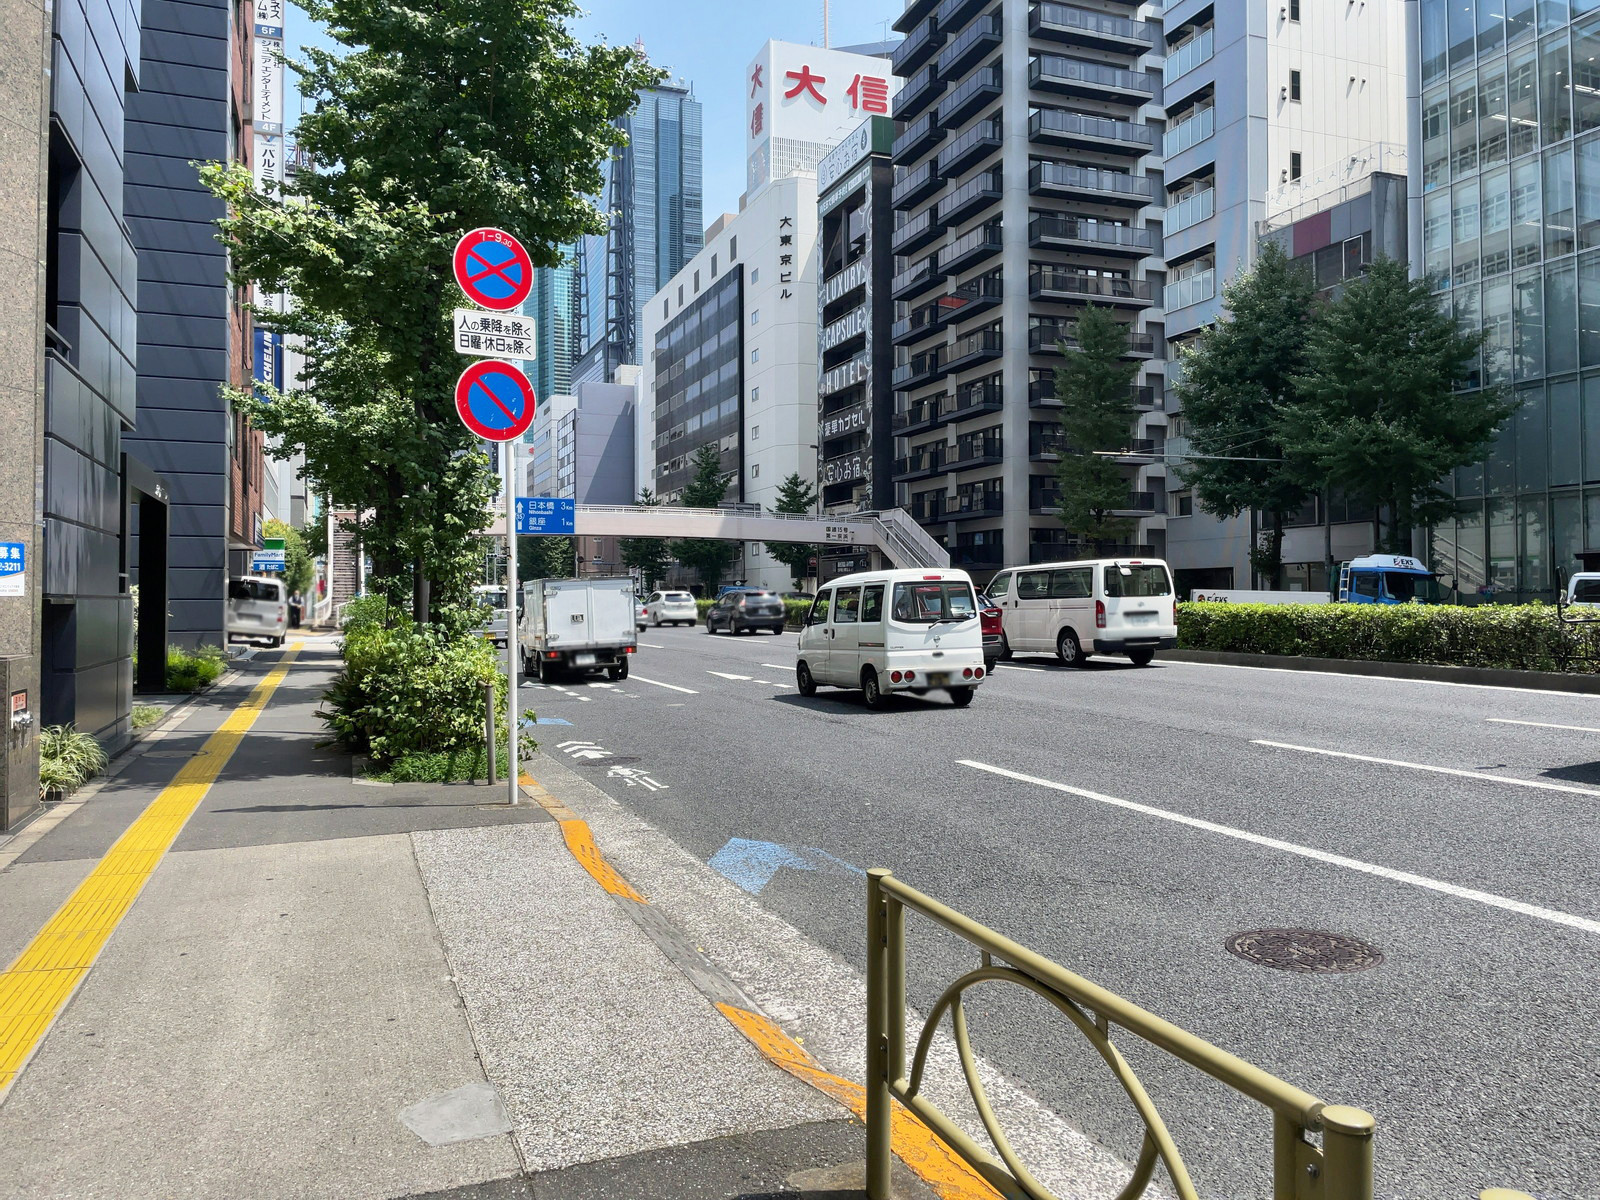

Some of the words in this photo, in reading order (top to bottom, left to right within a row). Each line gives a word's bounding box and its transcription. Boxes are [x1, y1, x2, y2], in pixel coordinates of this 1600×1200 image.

[751, 64, 763, 139] 大信
[784, 65, 889, 113] 大信
[262, 122, 276, 131] 4F
[828, 142, 858, 180] 安心お宿
[779, 216, 793, 300] 大東京ビル
[826, 261, 863, 303] LUXURY
[459, 315, 532, 337] 人の乗降を除く
[826, 309, 863, 350] CAPSULE
[826, 360, 863, 394] HOTEL
[824, 410, 865, 437] 豪華カプセル
[826, 456, 862, 484] 安心お宿
[528, 501, 554, 511] 日本橋
[528, 517, 546, 526] 銀座
